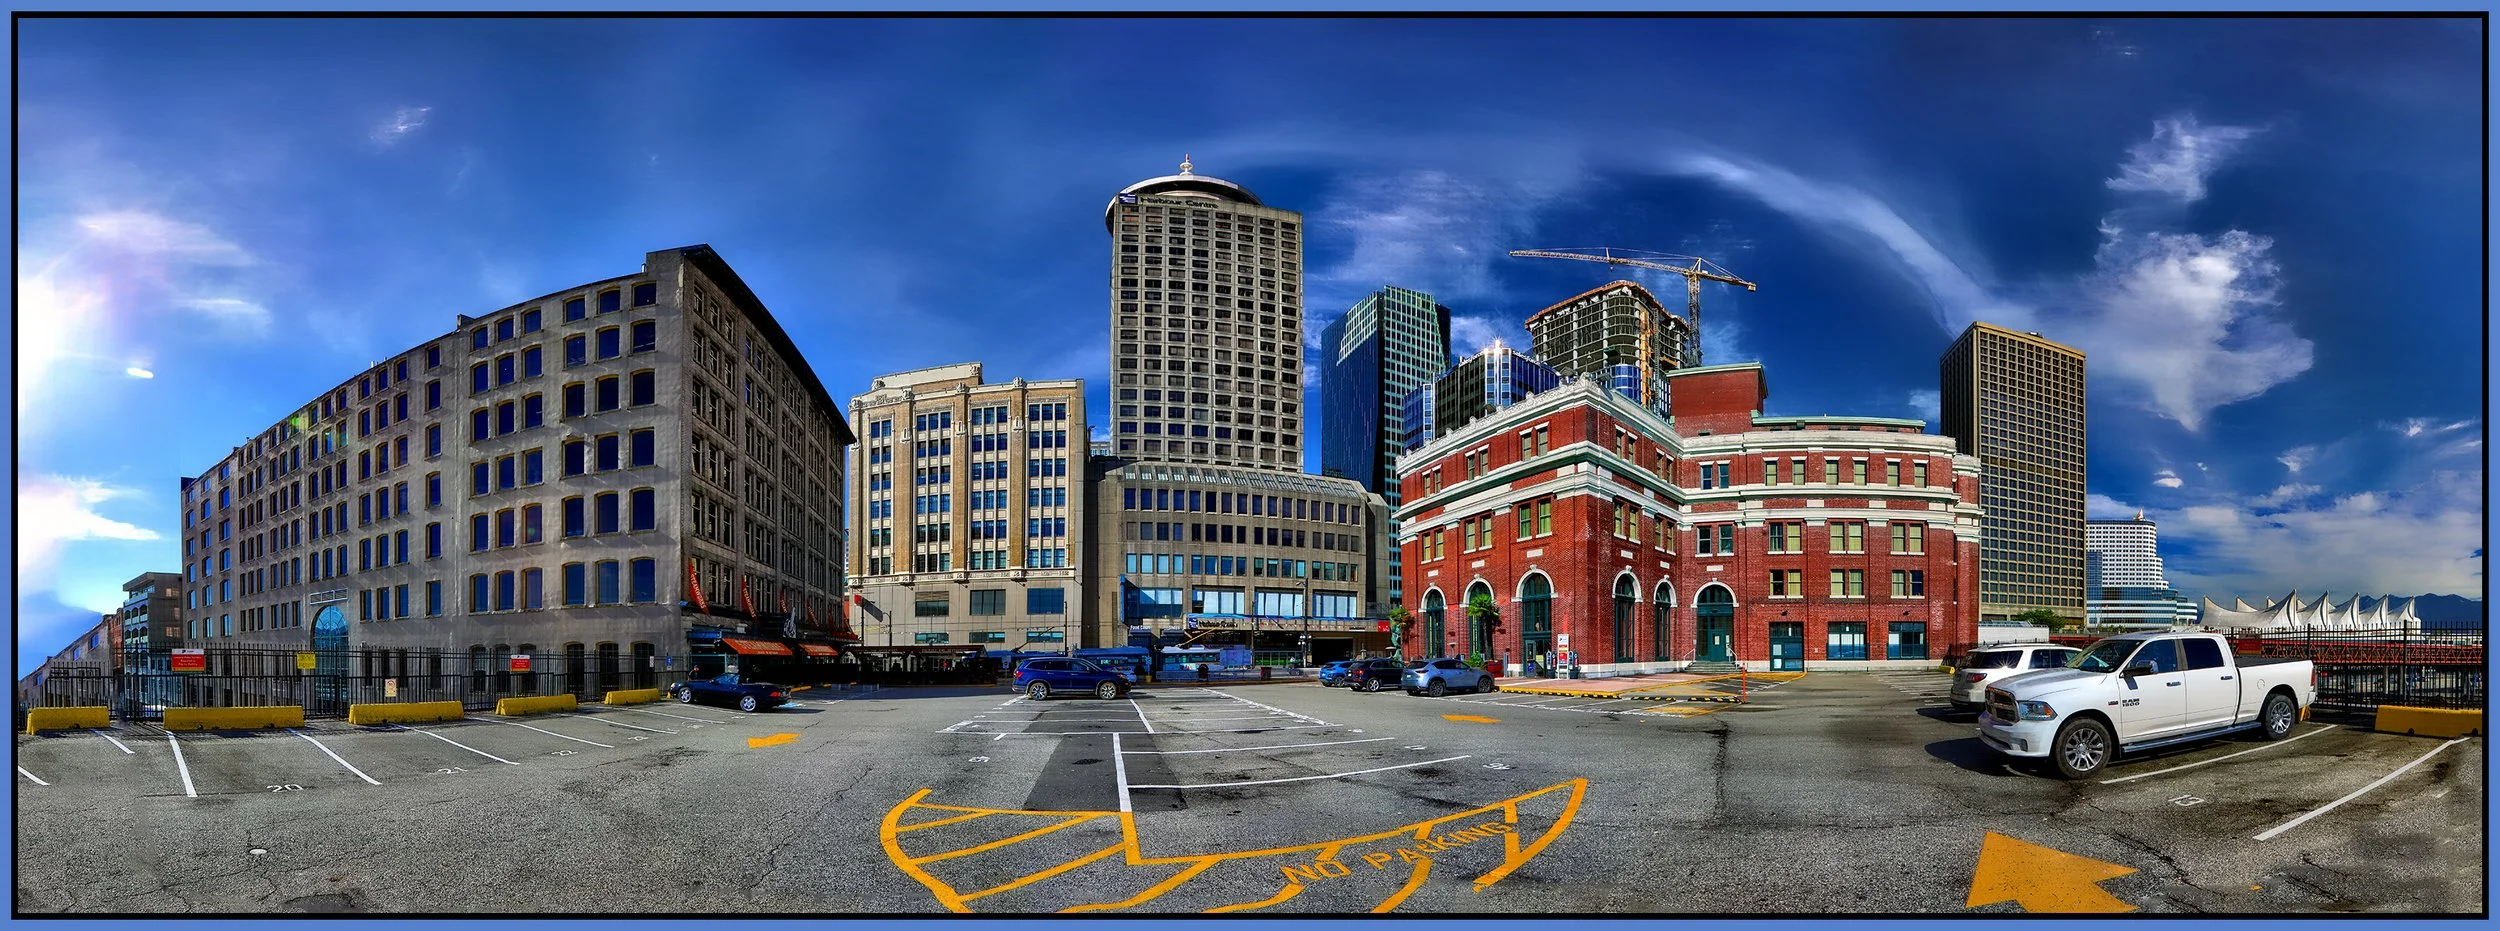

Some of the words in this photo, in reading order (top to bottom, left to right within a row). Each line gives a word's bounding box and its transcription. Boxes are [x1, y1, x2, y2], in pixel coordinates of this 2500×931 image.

[1185, 200, 1219, 209] Centre
[266, 783, 304, 792] 20
[1280, 860, 1353, 884] NO
[1361, 822, 1513, 870] PARKING
